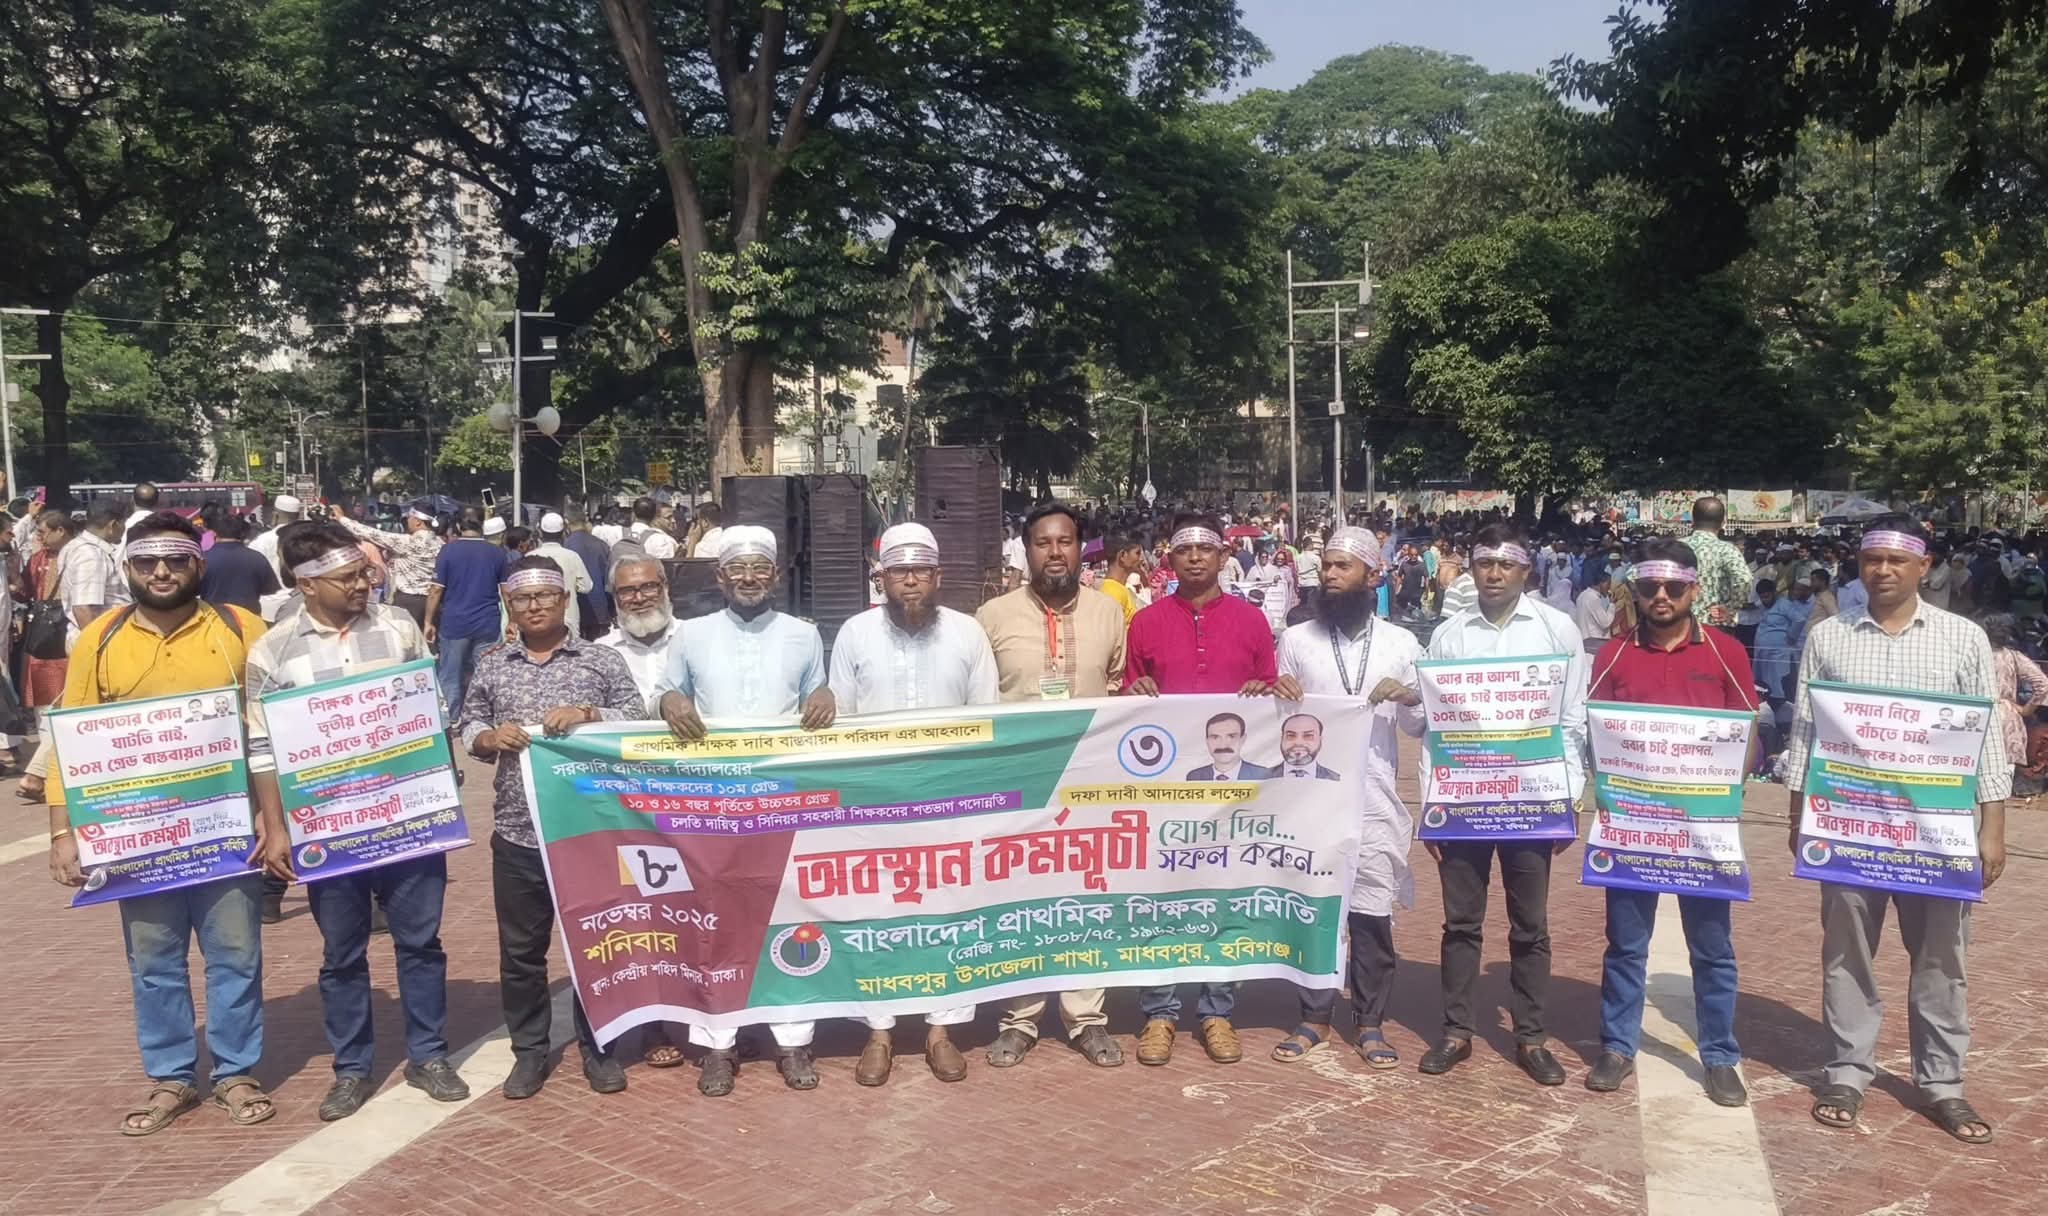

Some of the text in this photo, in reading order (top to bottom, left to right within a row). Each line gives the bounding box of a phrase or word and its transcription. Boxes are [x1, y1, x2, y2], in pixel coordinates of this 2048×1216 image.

[1436, 671, 1520, 685] আর নয় আশা
[308, 687, 387, 714] শিক্ষক কেন
[1440, 692, 1466, 704] এবার
[1471, 689, 1491, 703] চাই
[76, 706, 182, 735] যোগ্যতার কোন
[317, 703, 397, 738] তৃতীয় শ্রেণি?
[1433, 711, 1456, 722] ১০ম
[1496, 708, 1524, 720] ১০ম
[1844, 702, 1921, 723] সম্মান নিয়ে
[112, 729, 152, 749] ঘাটতি
[633, 736, 687, 753] প্রাথমিক
[744, 735, 774, 750] দাবি
[779, 732, 838, 748] বাস্তবায়ন
[844, 729, 890, 745] পরিষদ
[896, 729, 917, 740] এর
[921, 725, 980, 738] আহবানে
[1604, 718, 1696, 736] আর নয় আলাপন
[1856, 722, 1897, 741] বাঁচতে
[288, 745, 321, 764] ১০ম
[327, 736, 361, 755] গ্রেডে
[365, 725, 393, 749] মুক্তি
[1130, 735, 1163, 766] ৩
[1621, 739, 1645, 752] এবার
[1649, 739, 1667, 754] চাই
[1852, 744, 1896, 762] শিক্ষকের
[1900, 754, 1924, 764] ১০ম
[1928, 754, 1950, 766] গ্রেড
[68, 761, 101, 777] ১০ম
[108, 756, 138, 773] গ্রেড
[142, 745, 204, 765] বাস্তবায়ন
[552, 759, 752, 776] সরকারি প্রাথমিক বিদ্যালয়ের
[592, 778, 779, 794] সহকারী শিক্ষকদের ১০ম গ্রেড
[1071, 785, 1252, 802] দফা দাবী আদায়ের লক্ষ্যে
[303, 813, 353, 834] অবস্থান
[355, 794, 402, 826] কর্মসূচী
[629, 792, 830, 814] ১০ ও ১৬ বছর পূর্তিতে উচ্চতর গ্রেড
[670, 793, 1007, 833] চলতি দায়িত্ব ও সিনিয়র সহকারী শিক্ষকদের শতভাগ পদোন্নতি
[139, 817, 191, 848] কর্মসূচী
[1159, 819, 1218, 846] যোগ
[1816, 813, 1864, 837] অবস্থান
[1867, 818, 1917, 848] কর্মসূচী
[637, 850, 678, 888] ৮
[794, 808, 1150, 904] অবস্থান কর্মসূচী
[1157, 846, 1230, 872] সফল
[578, 903, 719, 933] নভেম্বর ২০২৫
[841, 915, 986, 952] বাংলাদেশ
[997, 899, 1114, 936] প্রাথমিক
[1125, 895, 1218, 923] শিক্ষক
[1228, 888, 1319, 924] সমিতি
[584, 930, 678, 963] শনিবার
[947, 940, 993, 964] (রেজি
[612, 962, 648, 985] কেন্দ্রীয়
[650, 960, 677, 976] শহিদ
[856, 973, 947, 995] মাধবপুর
[954, 953, 1045, 983] উপজেলা
[1053, 948, 1109, 969] শাখা,
[1117, 943, 1211, 964] মাধবপুর,
